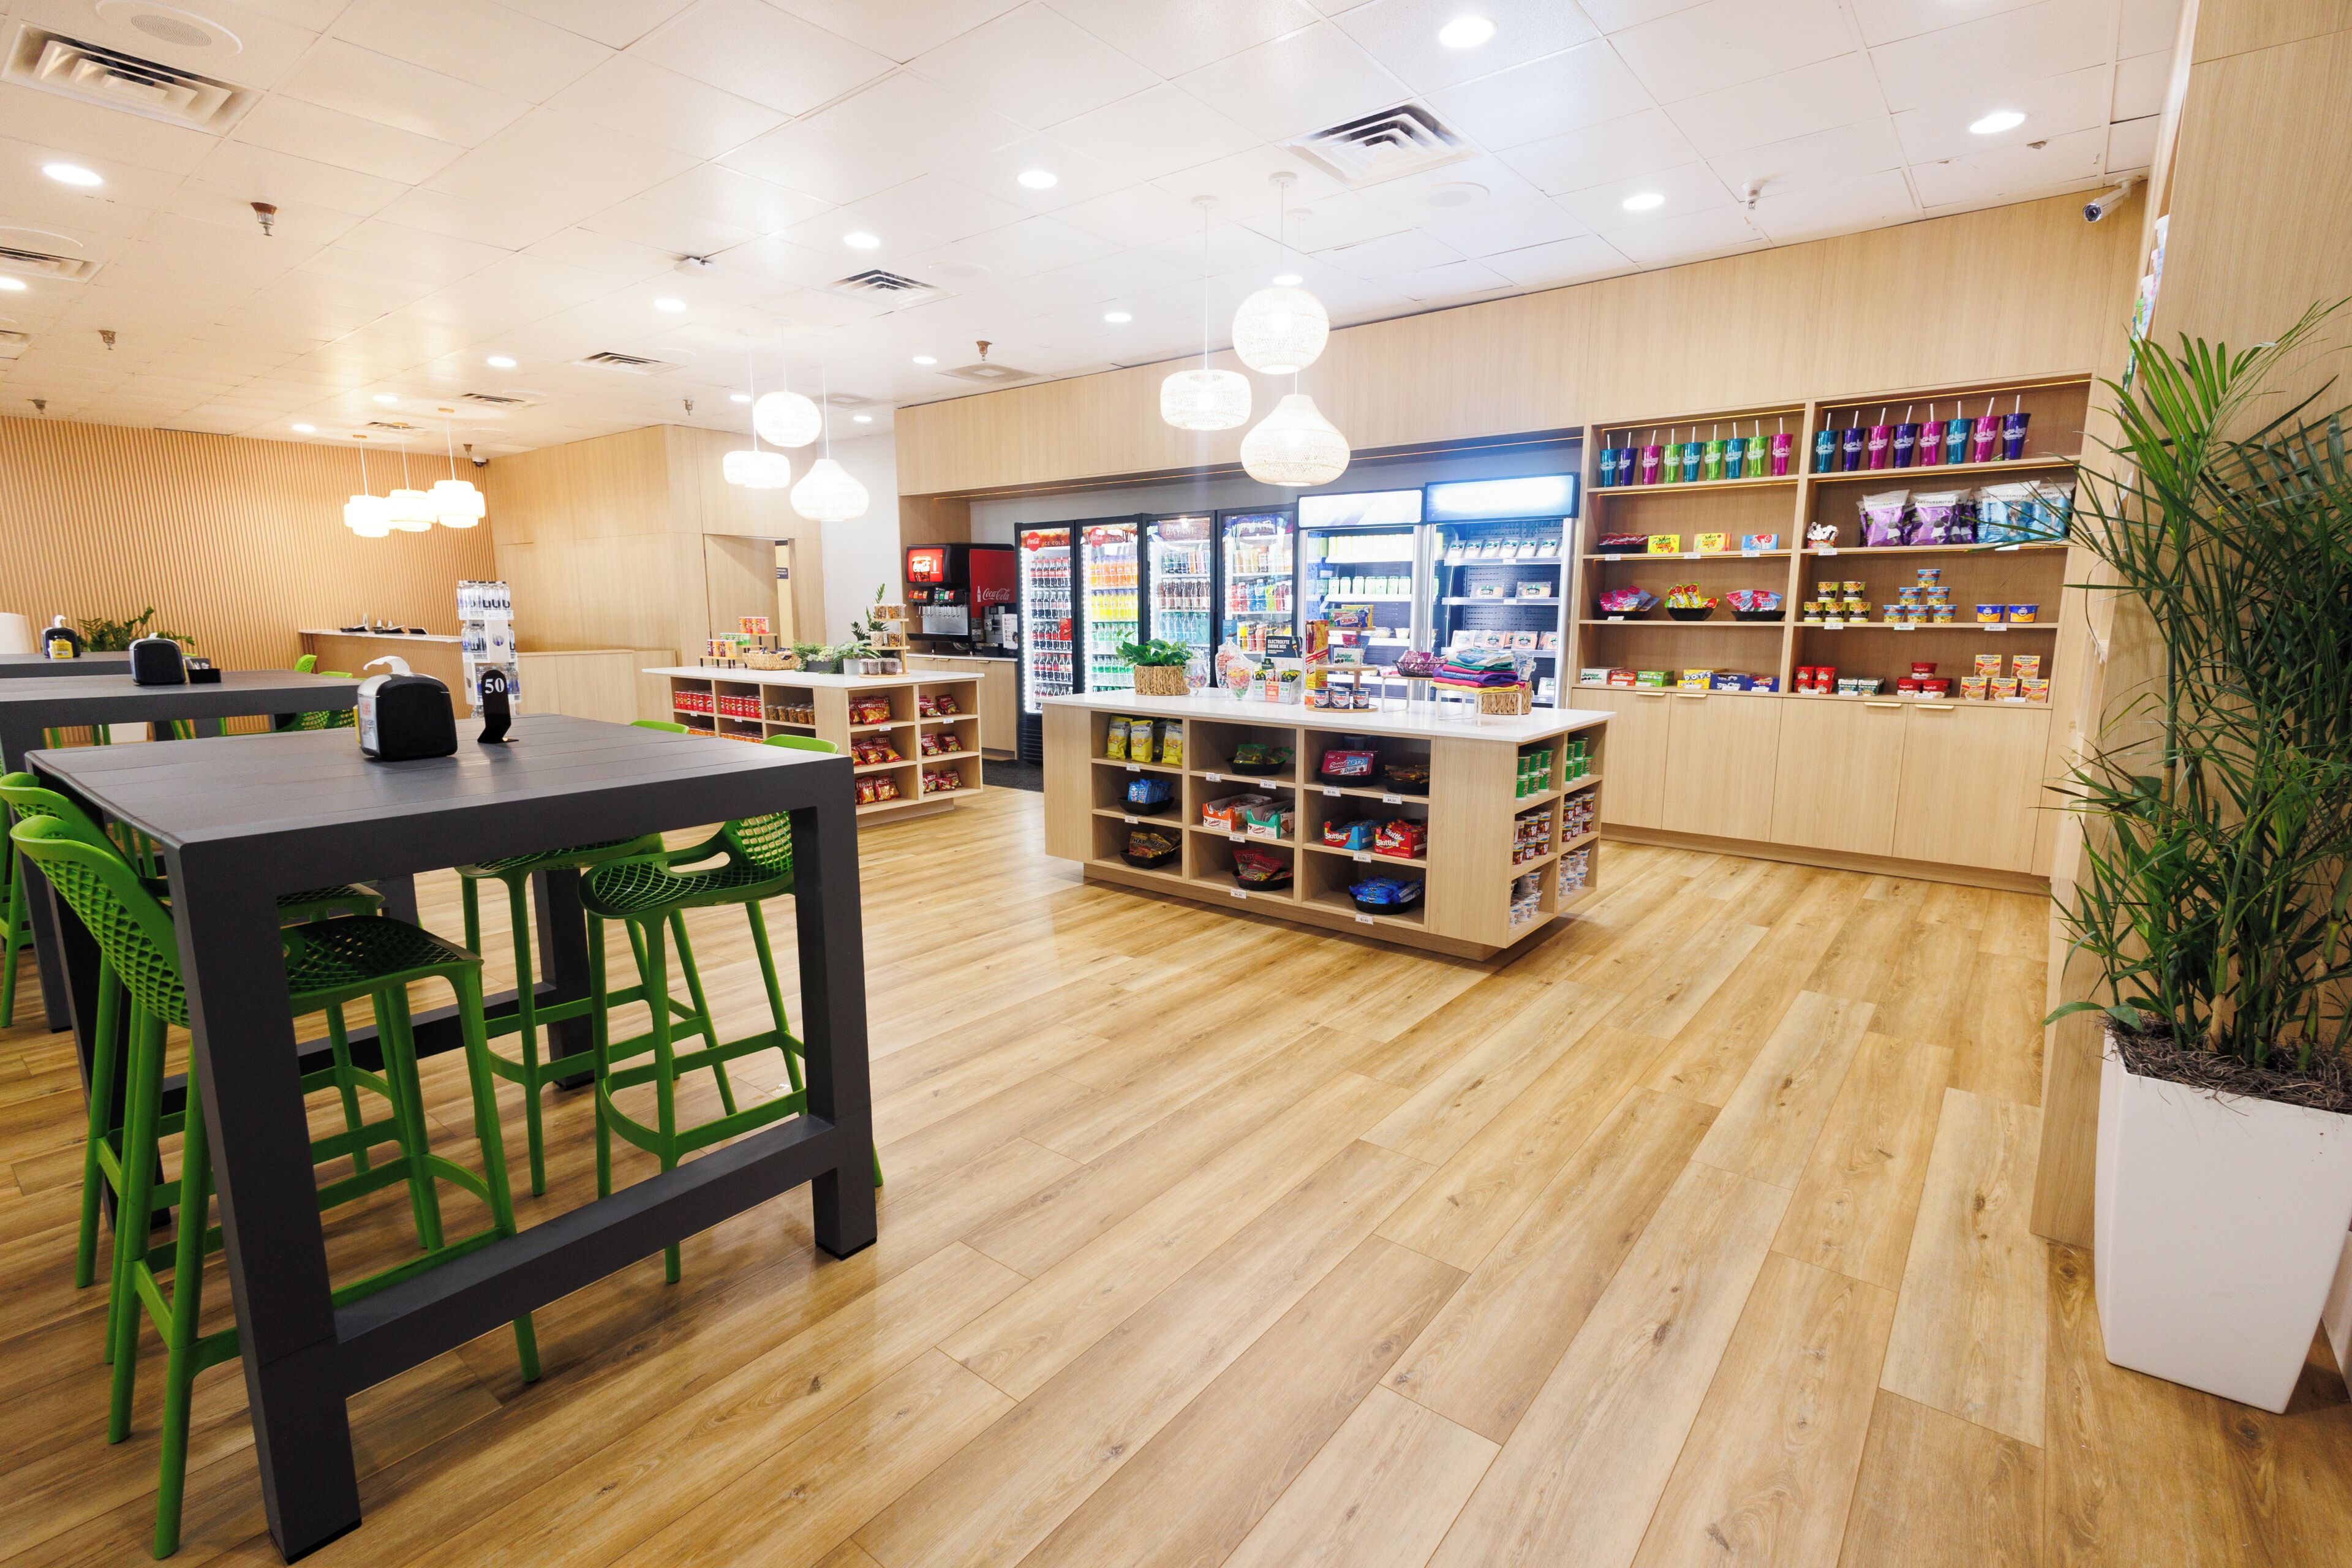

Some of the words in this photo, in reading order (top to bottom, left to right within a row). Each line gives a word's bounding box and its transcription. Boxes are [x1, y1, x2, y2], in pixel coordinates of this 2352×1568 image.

[982, 588, 1011, 600] Coca-Cola
[1684, 671, 1711, 680] DOTS
[484, 678, 505, 694] 50
